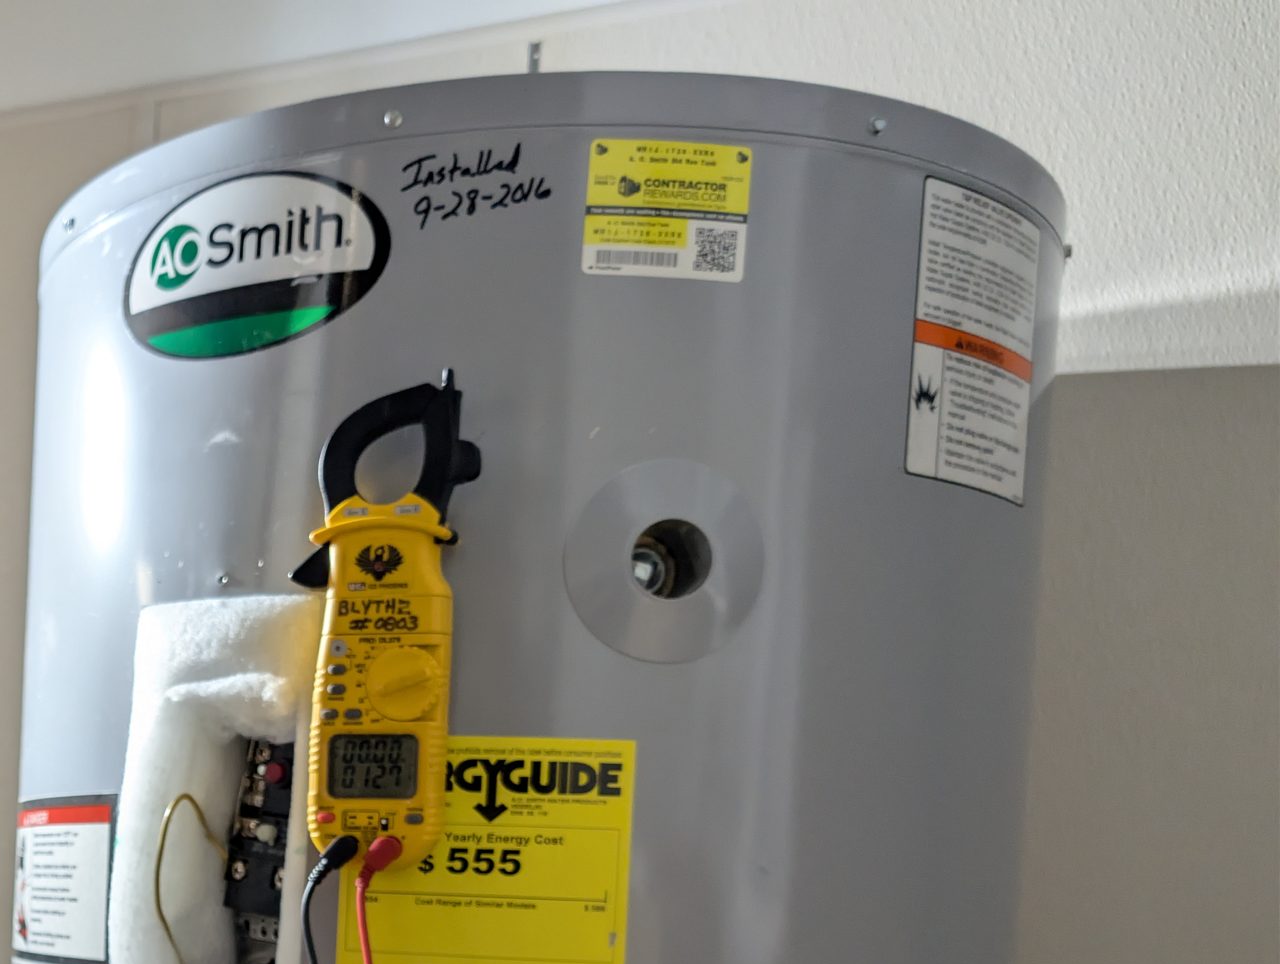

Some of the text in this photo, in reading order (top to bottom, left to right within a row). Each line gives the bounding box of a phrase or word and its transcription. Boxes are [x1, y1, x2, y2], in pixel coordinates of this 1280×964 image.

[401, 143, 521, 191] Installed
[643, 178, 727, 192] CONTRACTOR
[643, 189, 727, 202] REWARDS.COM
[413, 177, 552, 230] 9-28-2016
[444, 832, 564, 846] Yearly Energy Cost
[417, 847, 522, 876] $ 555
